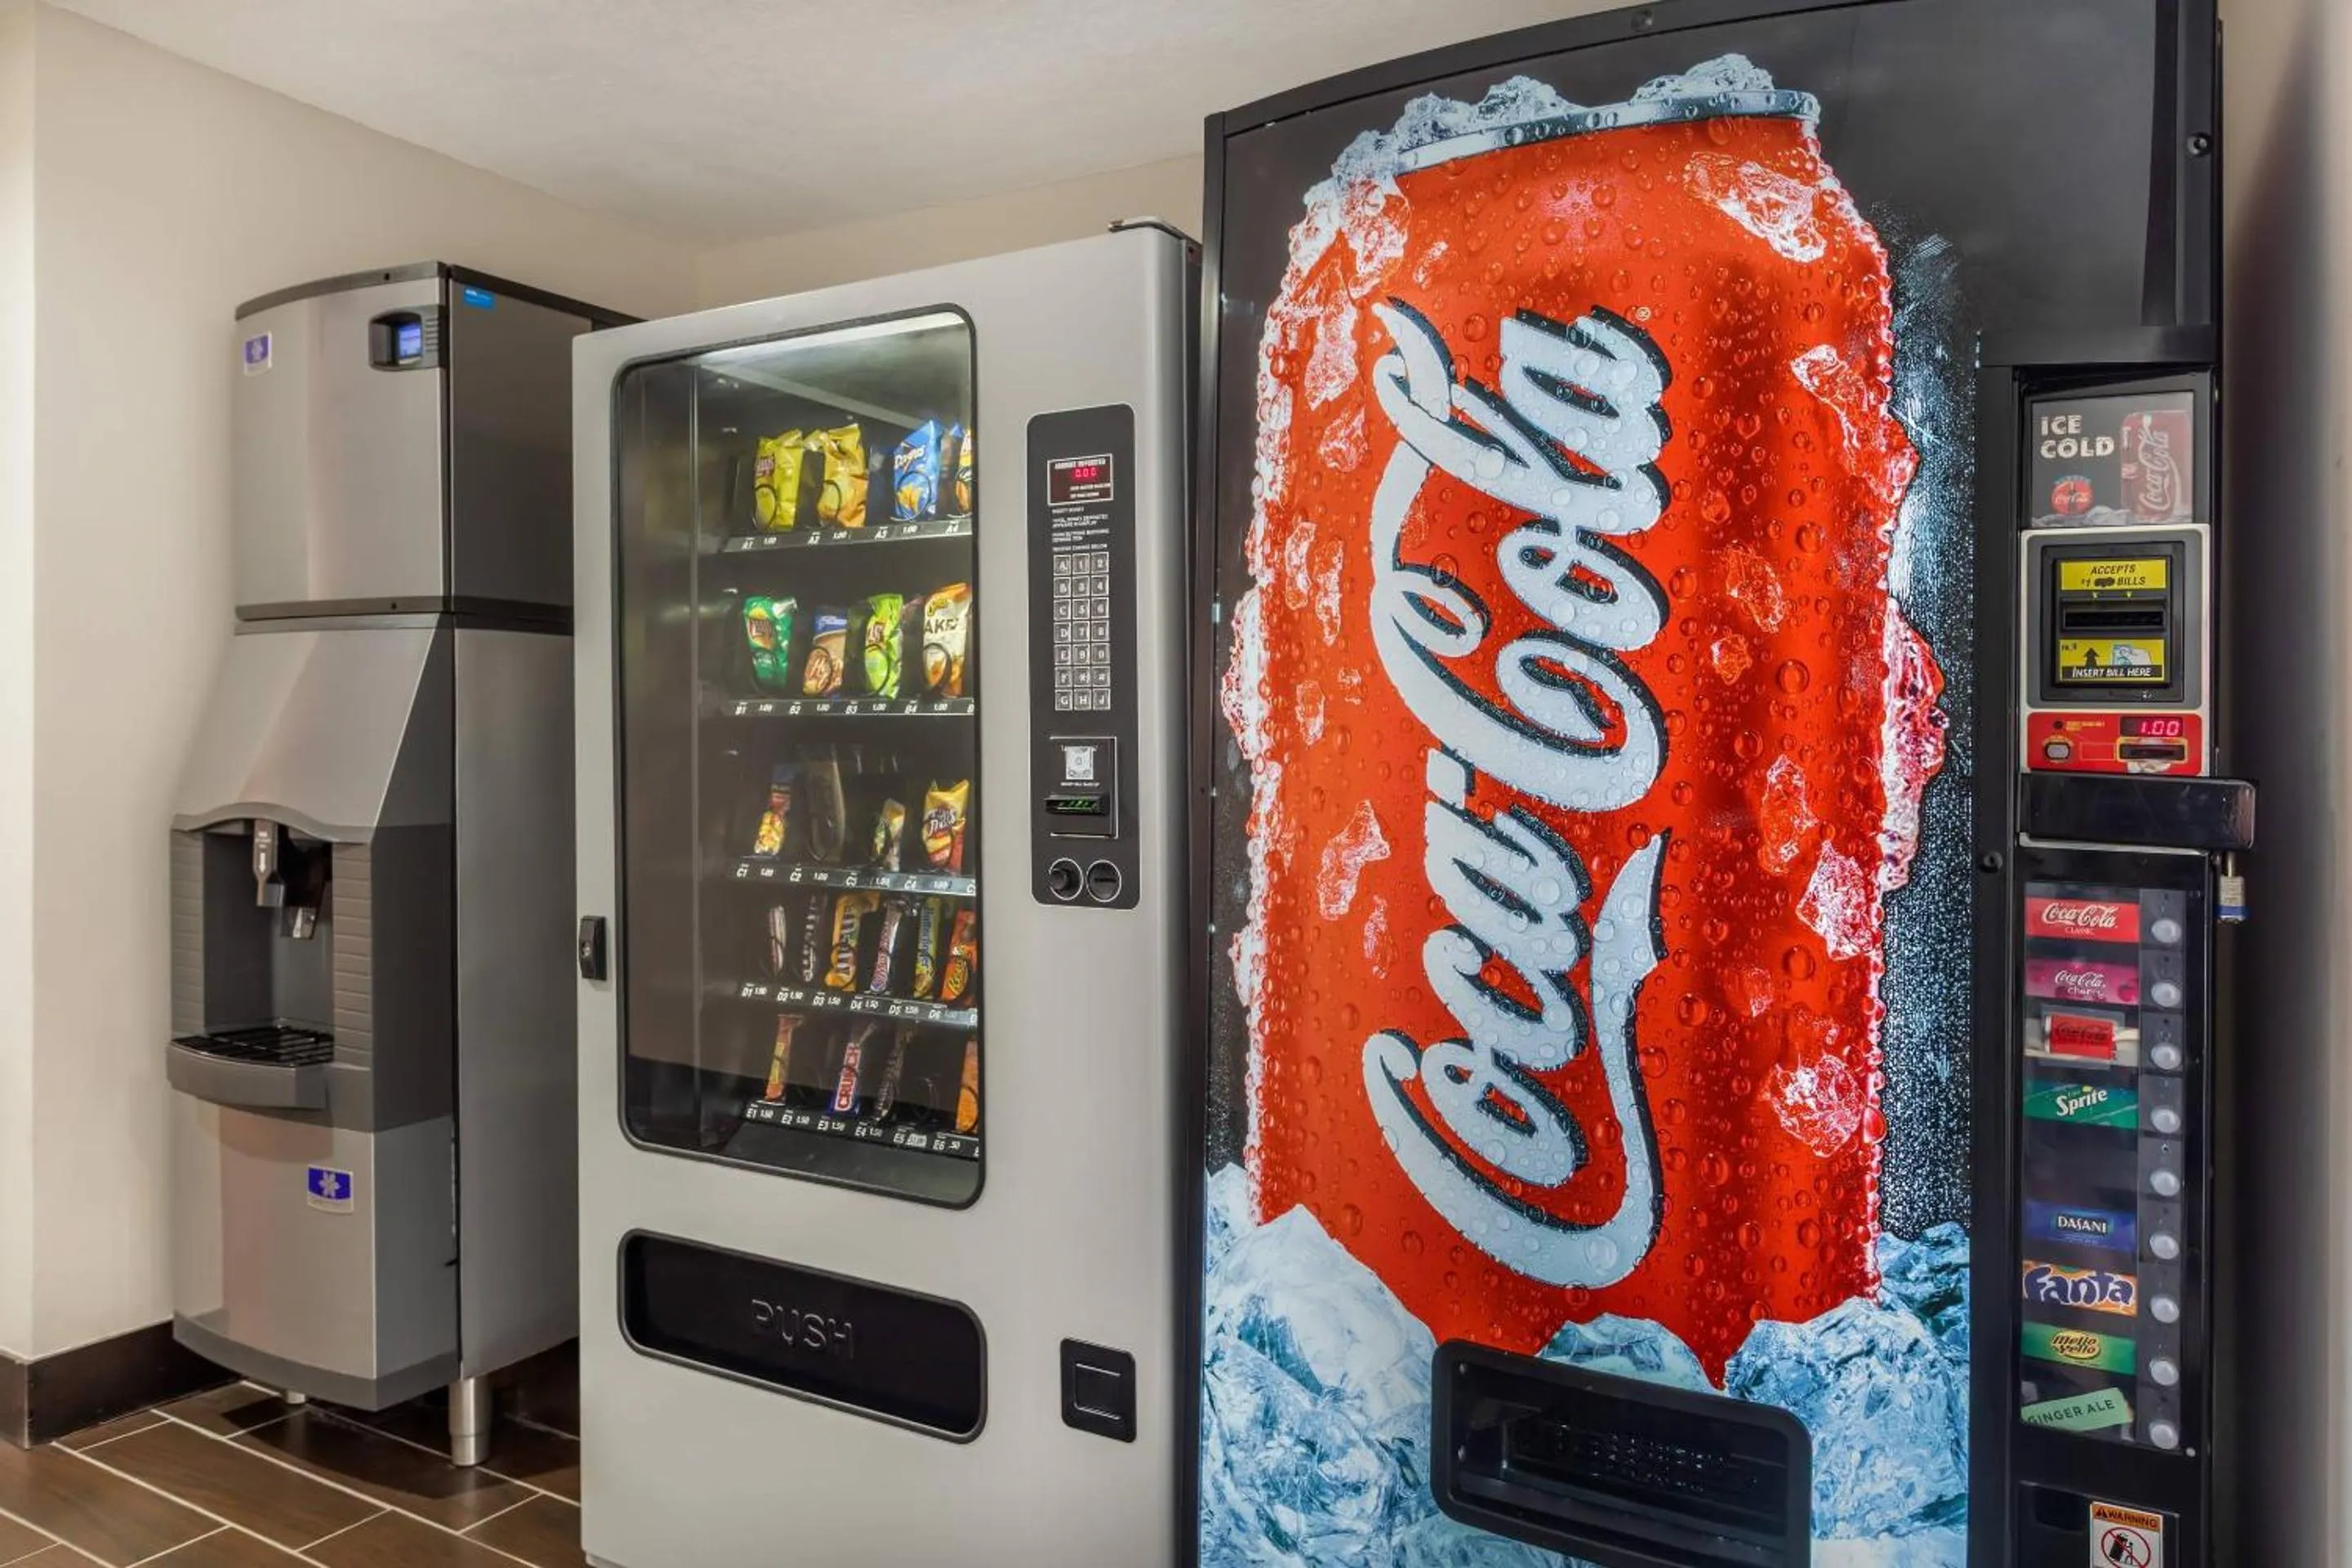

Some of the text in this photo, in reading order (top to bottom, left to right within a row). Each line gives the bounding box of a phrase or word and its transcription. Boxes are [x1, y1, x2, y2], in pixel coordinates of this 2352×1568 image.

[2041, 414, 2082, 435] ICE
[2040, 436, 2114, 459] COLD
[2091, 564, 2136, 574] ACCEPTS
[2117, 577, 2145, 586] BILLS
[2072, 666, 2104, 678] INSERT
[2127, 667, 2152, 677] HERE
[2140, 720, 2180, 736] 1.00
[1362, 297, 1672, 1290] Coca-Cola
[2042, 902, 2118, 929] Coca-Cola
[2056, 1089, 2109, 1116] Sprite
[2057, 1214, 2107, 1233] DASANI
[2023, 1264, 2135, 1307] Fanta
[751, 1298, 854, 1360] PUSH
[2052, 1333, 2098, 1346] Mello
[2028, 1399, 2115, 1424] GINGER ALE
[2108, 1511, 2158, 1529] WARNING
